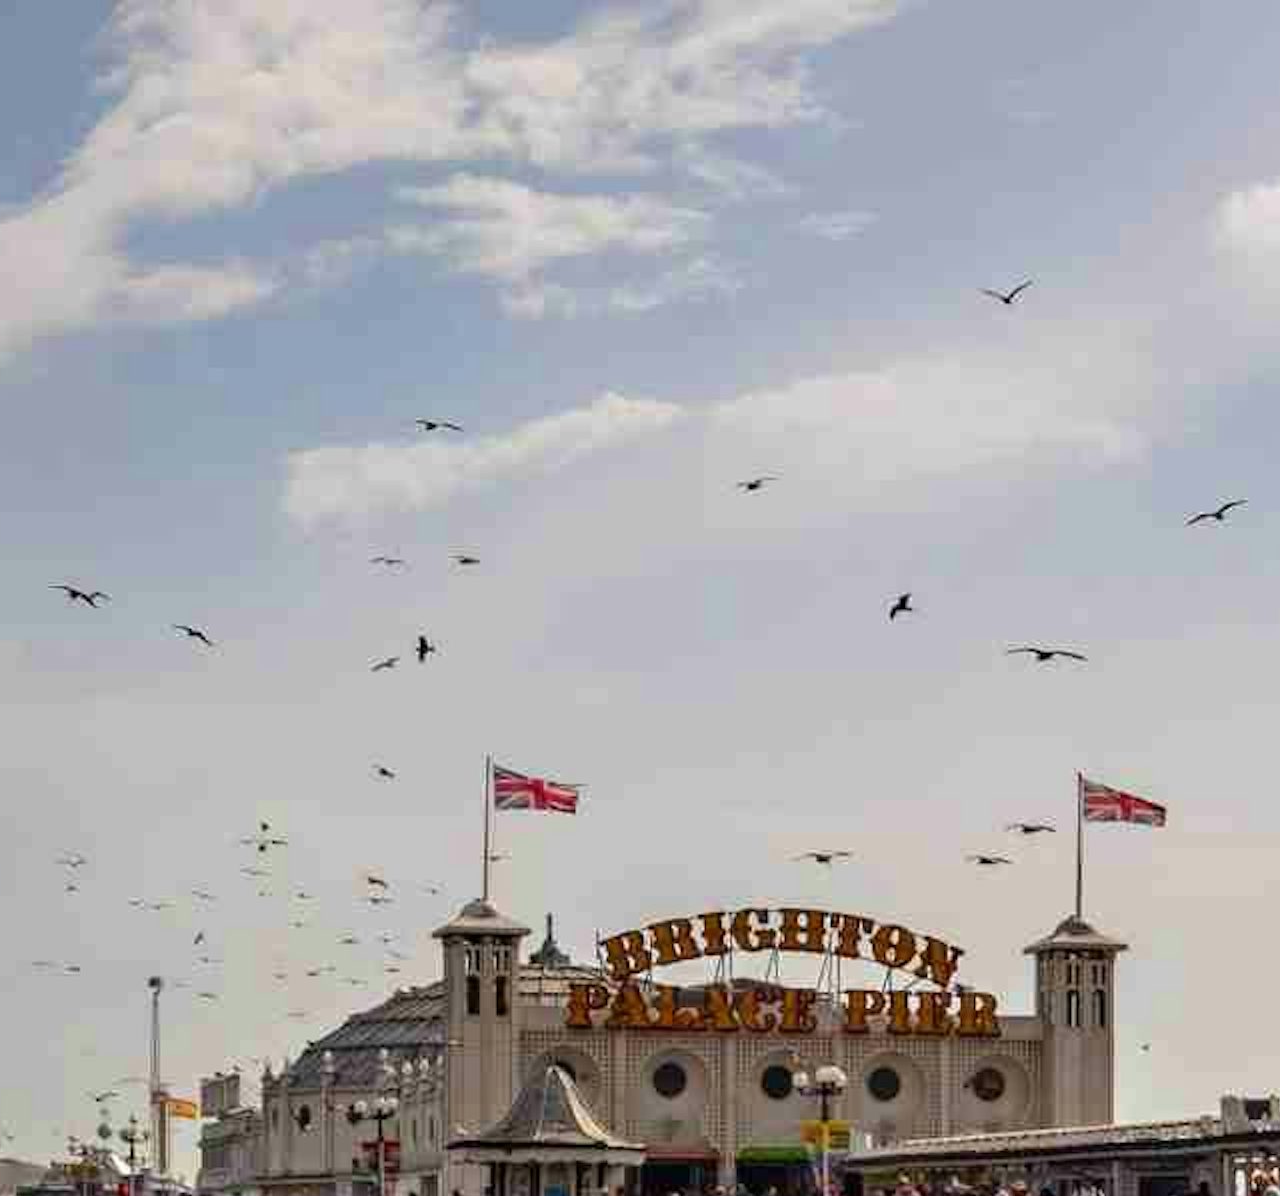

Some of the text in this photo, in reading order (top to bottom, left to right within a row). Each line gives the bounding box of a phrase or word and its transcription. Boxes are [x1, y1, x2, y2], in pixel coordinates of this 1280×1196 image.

[600, 908, 965, 987] BRIGHTON
[564, 980, 1001, 1037] PALACE PIER
